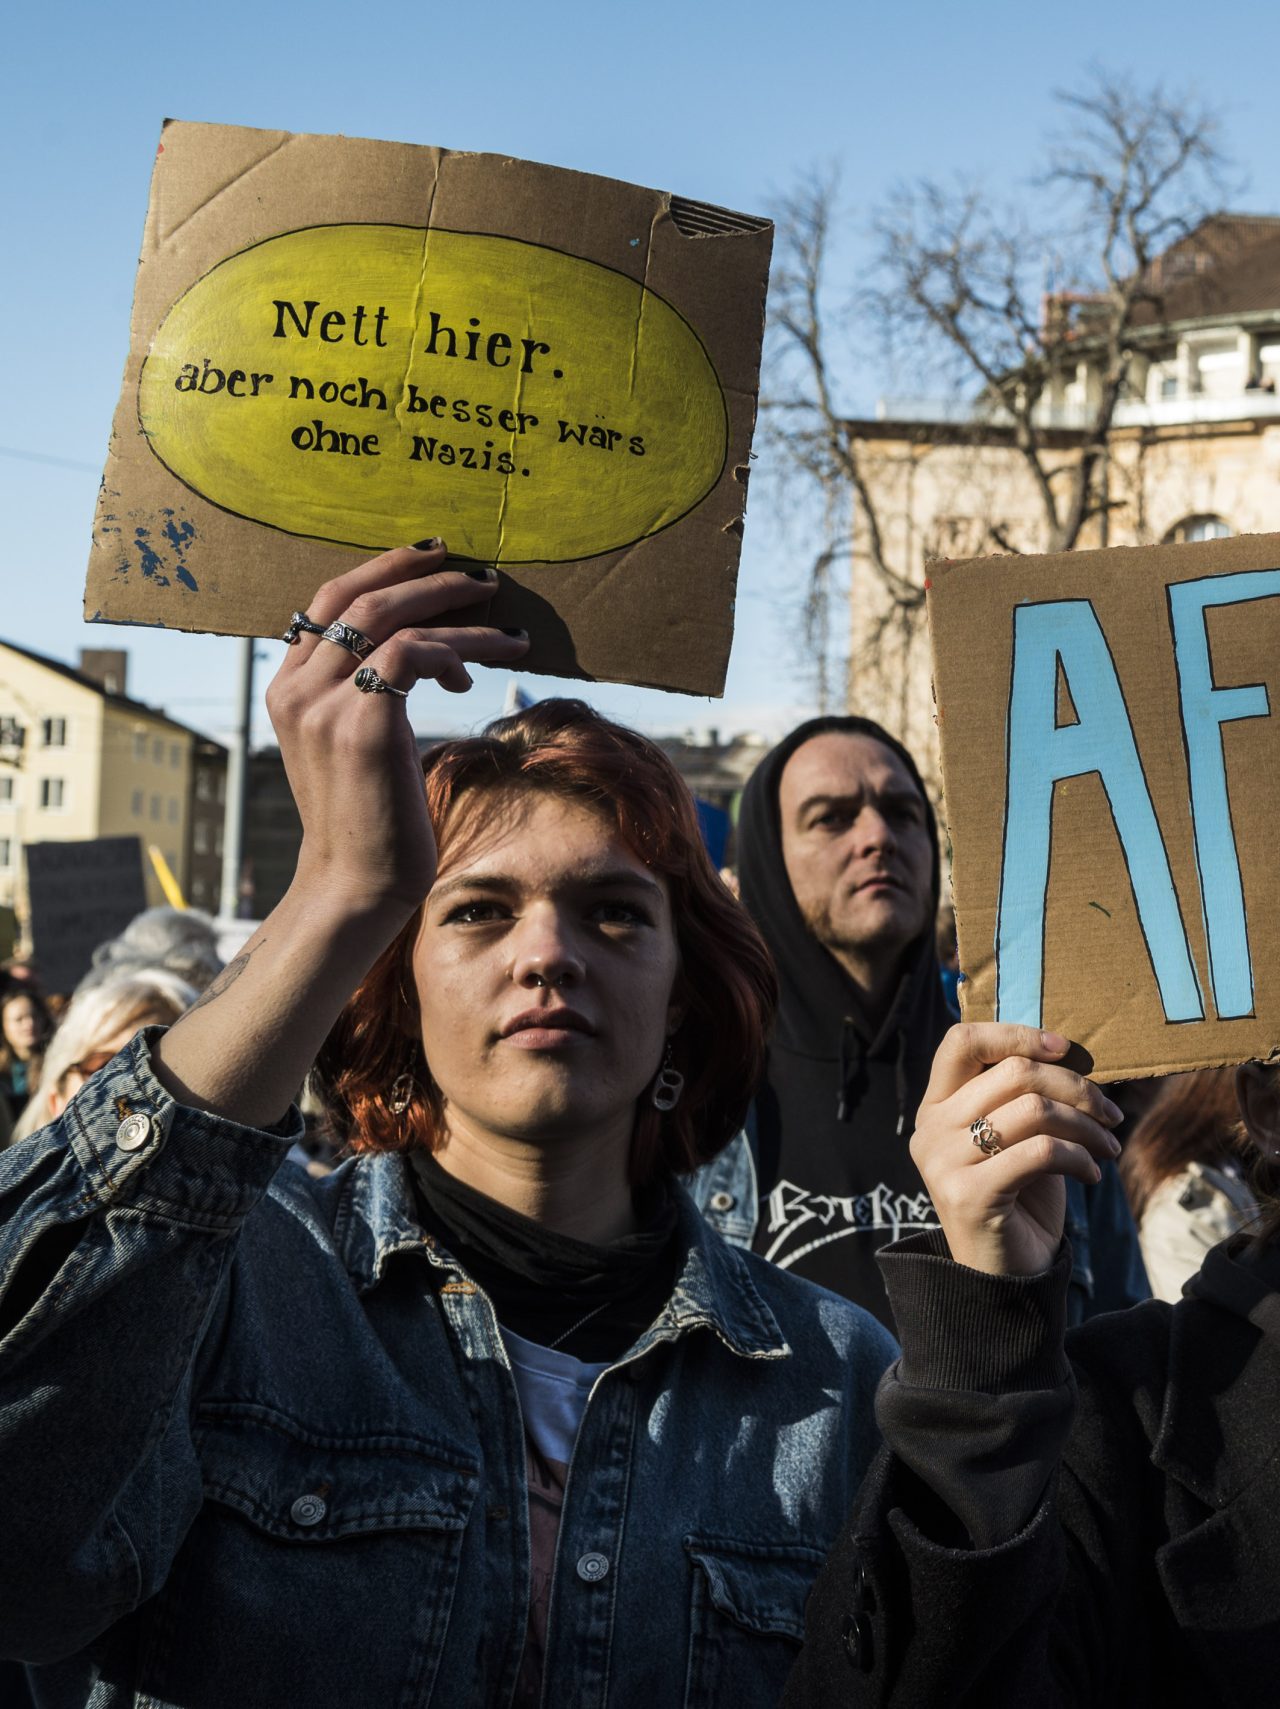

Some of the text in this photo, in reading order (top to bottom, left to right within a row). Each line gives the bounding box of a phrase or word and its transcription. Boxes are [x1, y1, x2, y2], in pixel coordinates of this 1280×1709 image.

[272, 300, 563, 378] Nett hier.
[175, 358, 646, 456] aber noch besser wärs
[291, 420, 529, 476] ohne Nazis.
